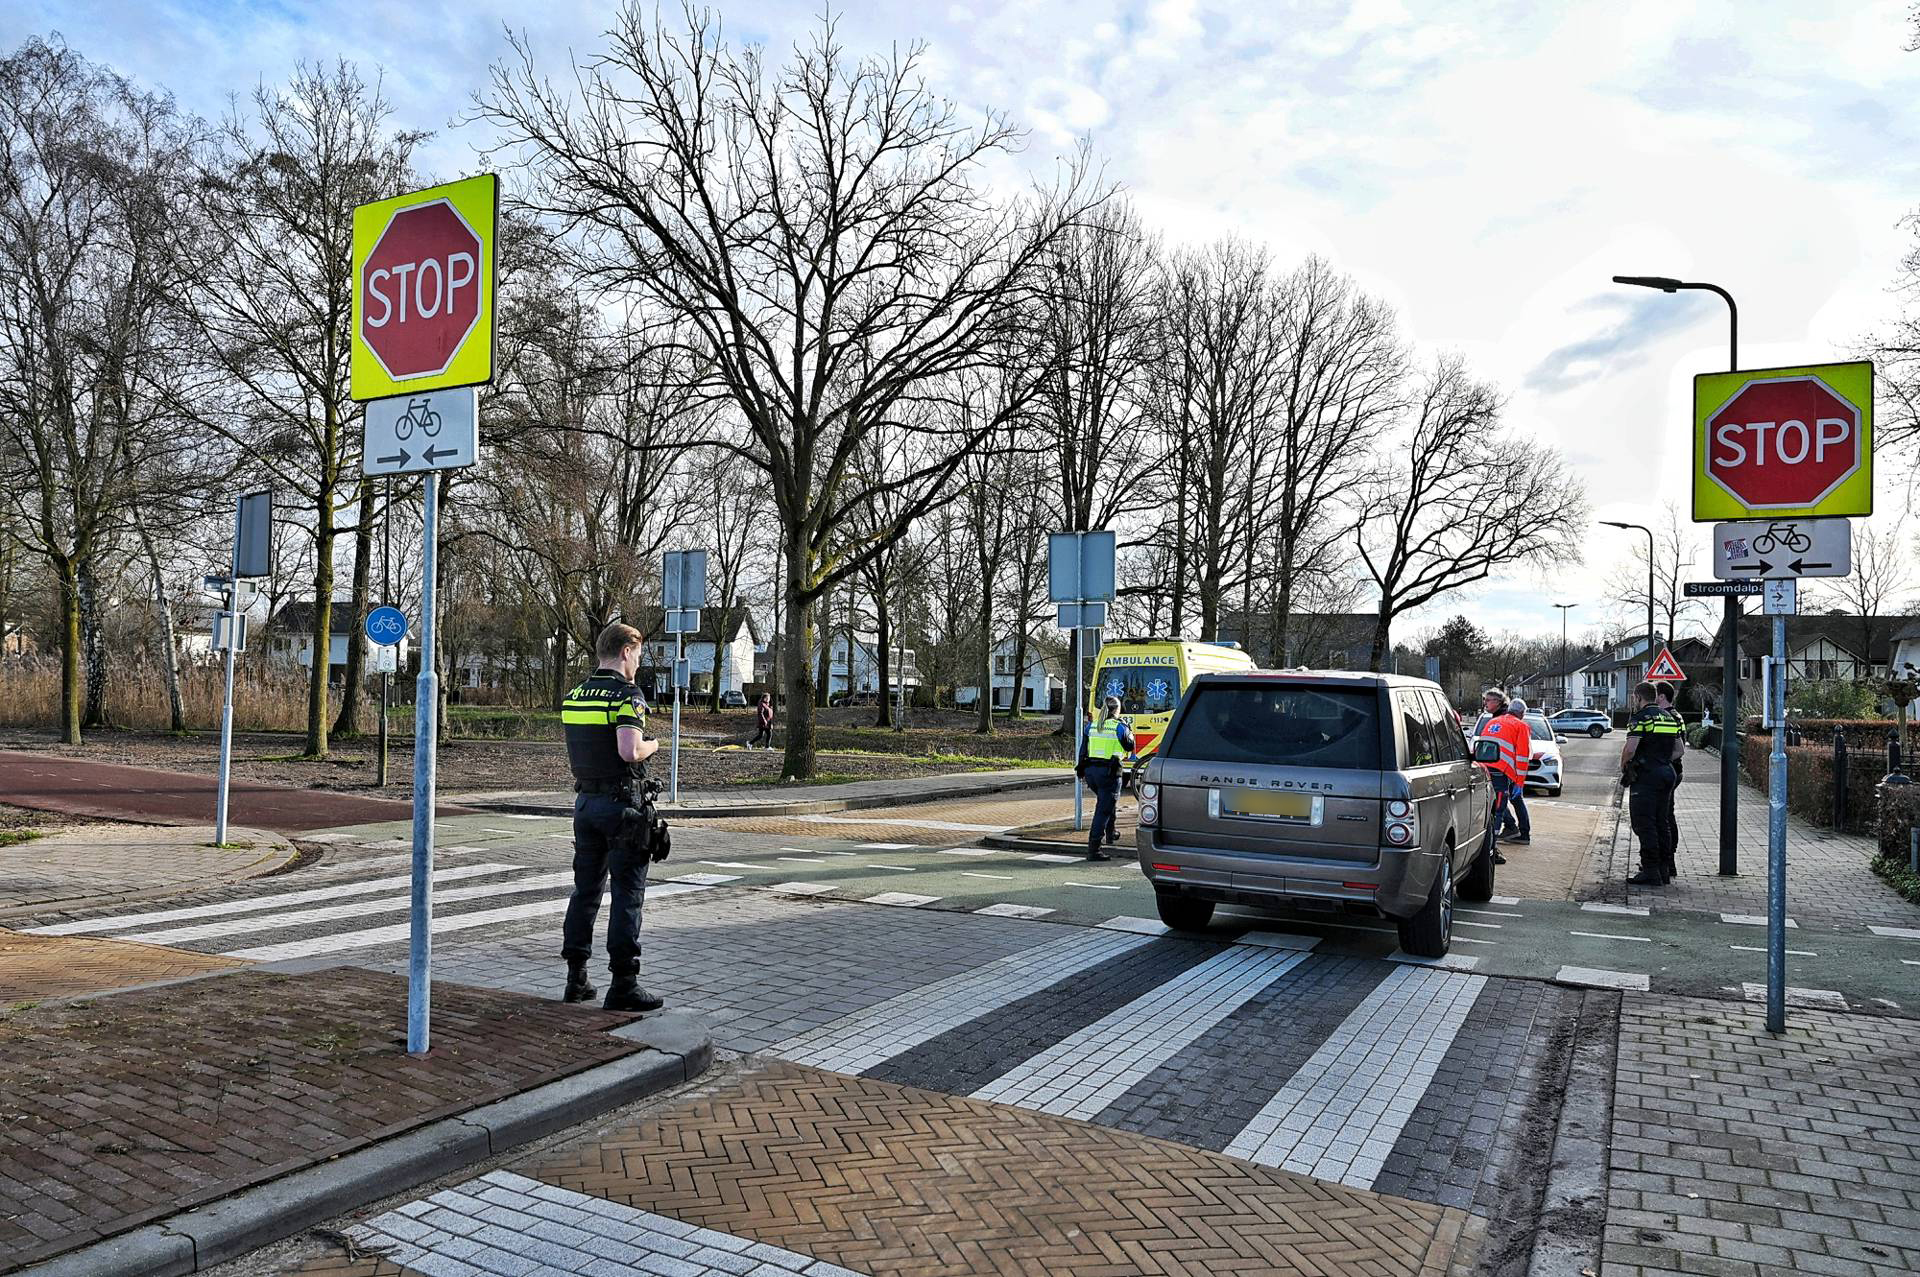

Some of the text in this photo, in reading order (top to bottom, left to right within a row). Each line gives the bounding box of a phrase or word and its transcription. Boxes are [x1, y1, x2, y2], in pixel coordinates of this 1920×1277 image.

[367, 252, 475, 328] STOP
[1714, 417, 1850, 468] STOP
[1690, 583, 1764, 593] Stroomdalpa
[1105, 656, 1175, 665] AMBULANCE
[1200, 775, 1334, 790] RANGE ROVER
